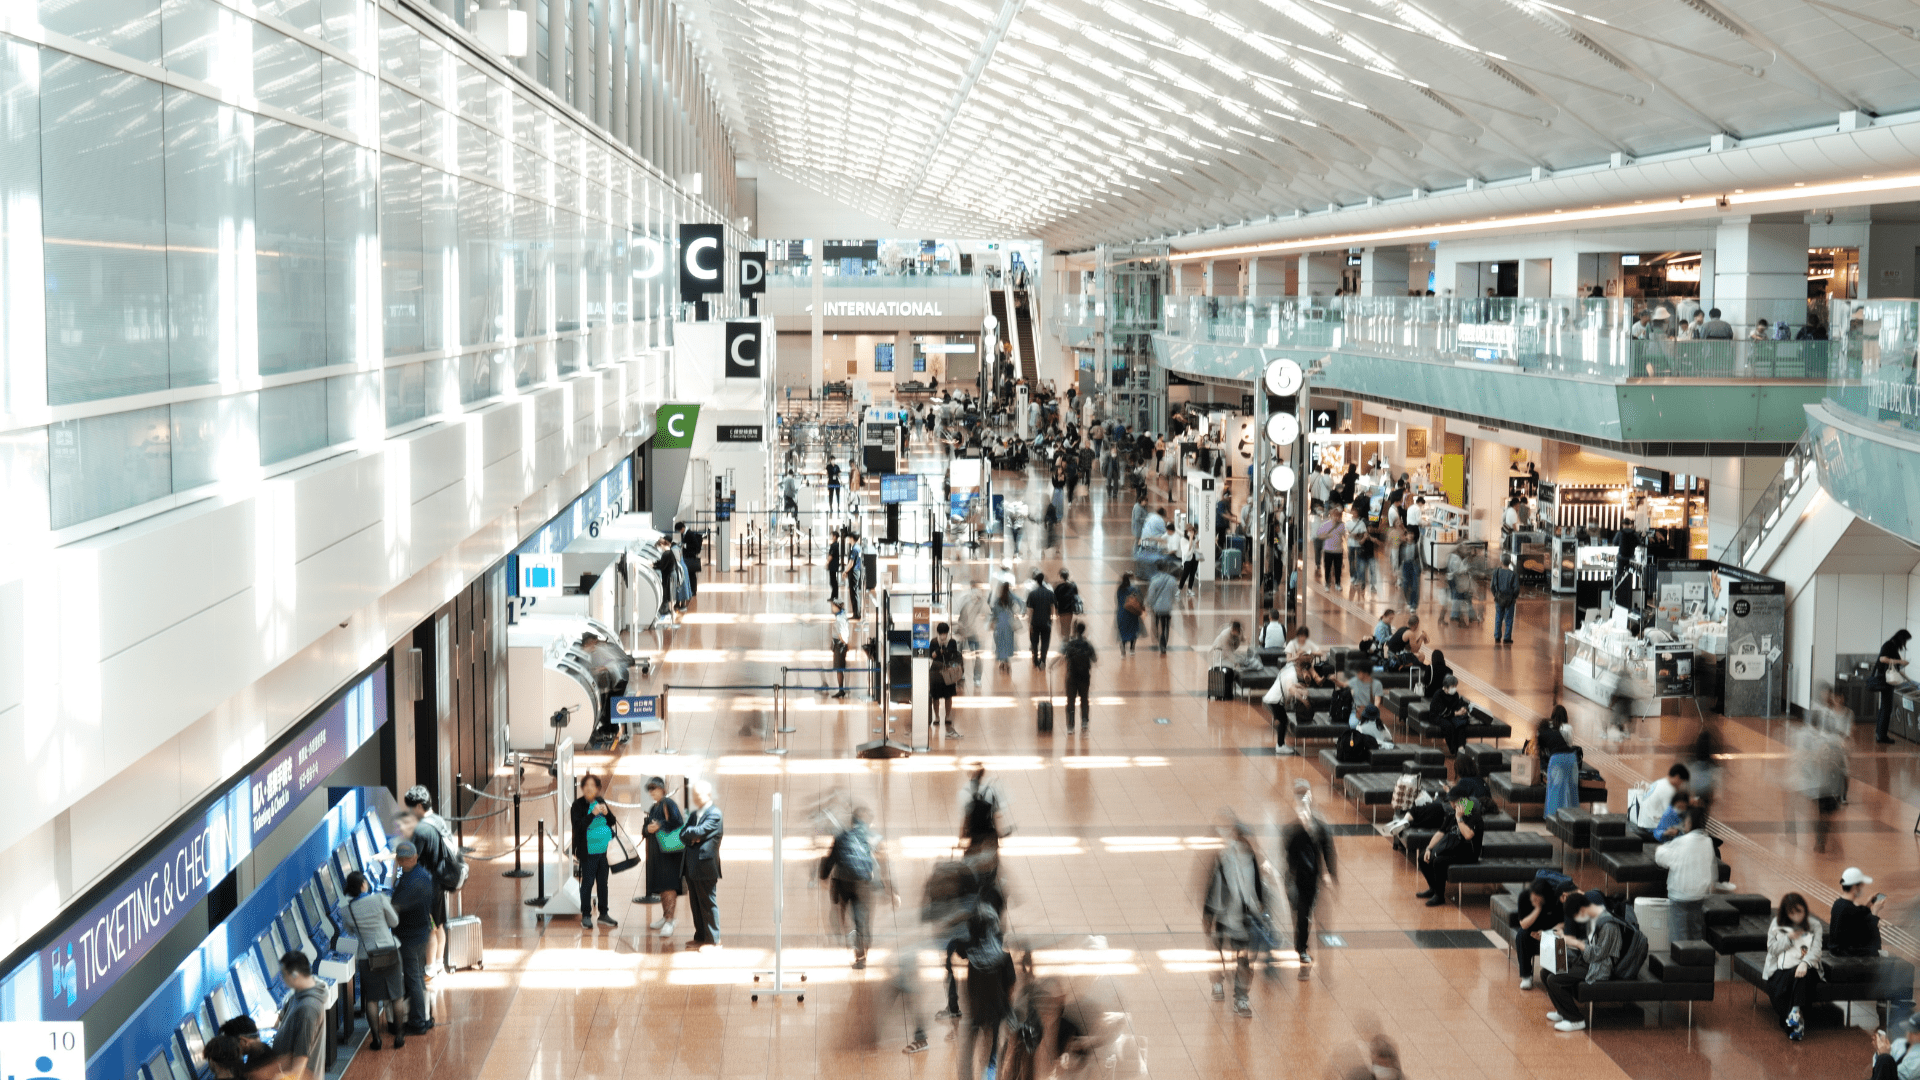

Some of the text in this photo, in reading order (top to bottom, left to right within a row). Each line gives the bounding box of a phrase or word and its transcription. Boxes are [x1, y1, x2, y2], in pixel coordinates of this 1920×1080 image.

[685, 237, 718, 280] C
[741, 259, 763, 285] D
[823, 301, 942, 316] INTERNATIONAL
[730, 332, 756, 367] C
[1277, 366, 1291, 389] 5
[1868, 378, 1889, 410] UPPER
[1890, 382, 1912, 415] DECK
[667, 414, 686, 438] C
[1204, 495, 1212, 532] Information
[589, 521, 599, 538] 6
[508, 601, 518, 625] 1
[252, 805, 271, 834] Ticketing
[79, 871, 161, 991] TICKETING
[163, 862, 175, 916] &
[49, 1031, 75, 1051] 10
